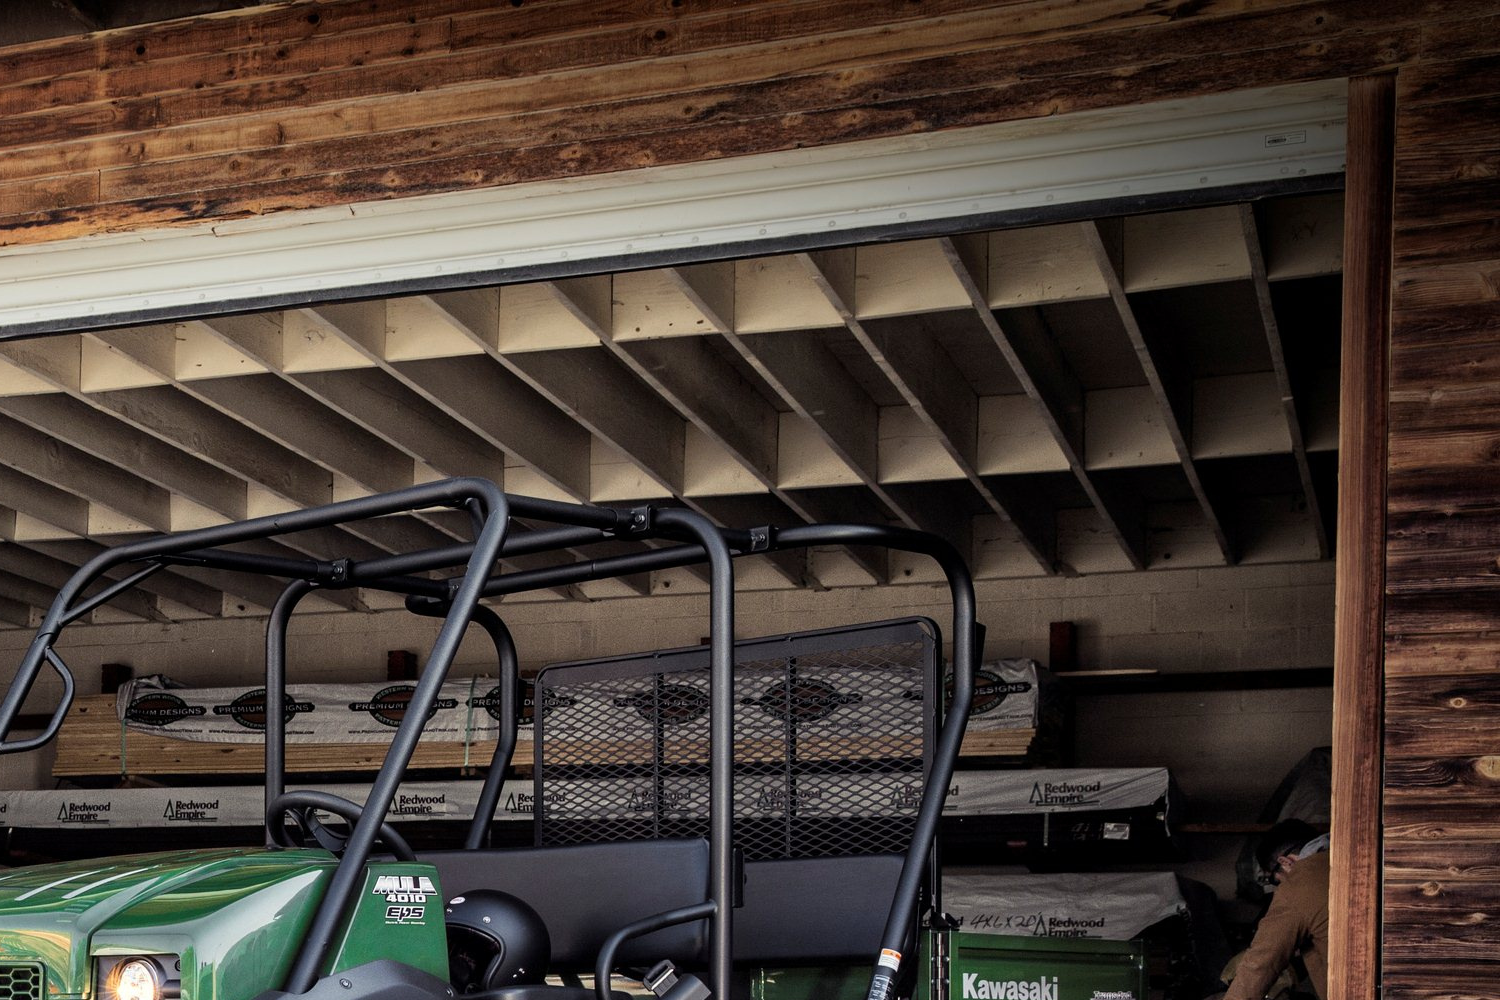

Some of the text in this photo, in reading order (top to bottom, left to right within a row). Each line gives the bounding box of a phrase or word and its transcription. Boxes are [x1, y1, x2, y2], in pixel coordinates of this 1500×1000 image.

[159, 707, 202, 716] DESIGNS
[218, 705, 263, 714] PREMIUM
[1044, 782, 1100, 793] Redwood
[400, 794, 445, 804] Redwood
[1044, 793, 1083, 804] Empire
[69, 802, 110, 812] Redwood
[176, 800, 219, 810] Redwood
[399, 804, 432, 814] Empire
[69, 812, 98, 821] Empire
[175, 810, 205, 820] Empire
[372, 875, 438, 896] MULE
[386, 894, 426, 903] 4010
[1049, 917, 1104, 928] Redwood
[1048, 928, 1087, 938] Empire
[962, 972, 1059, 1000] Kawasaki
